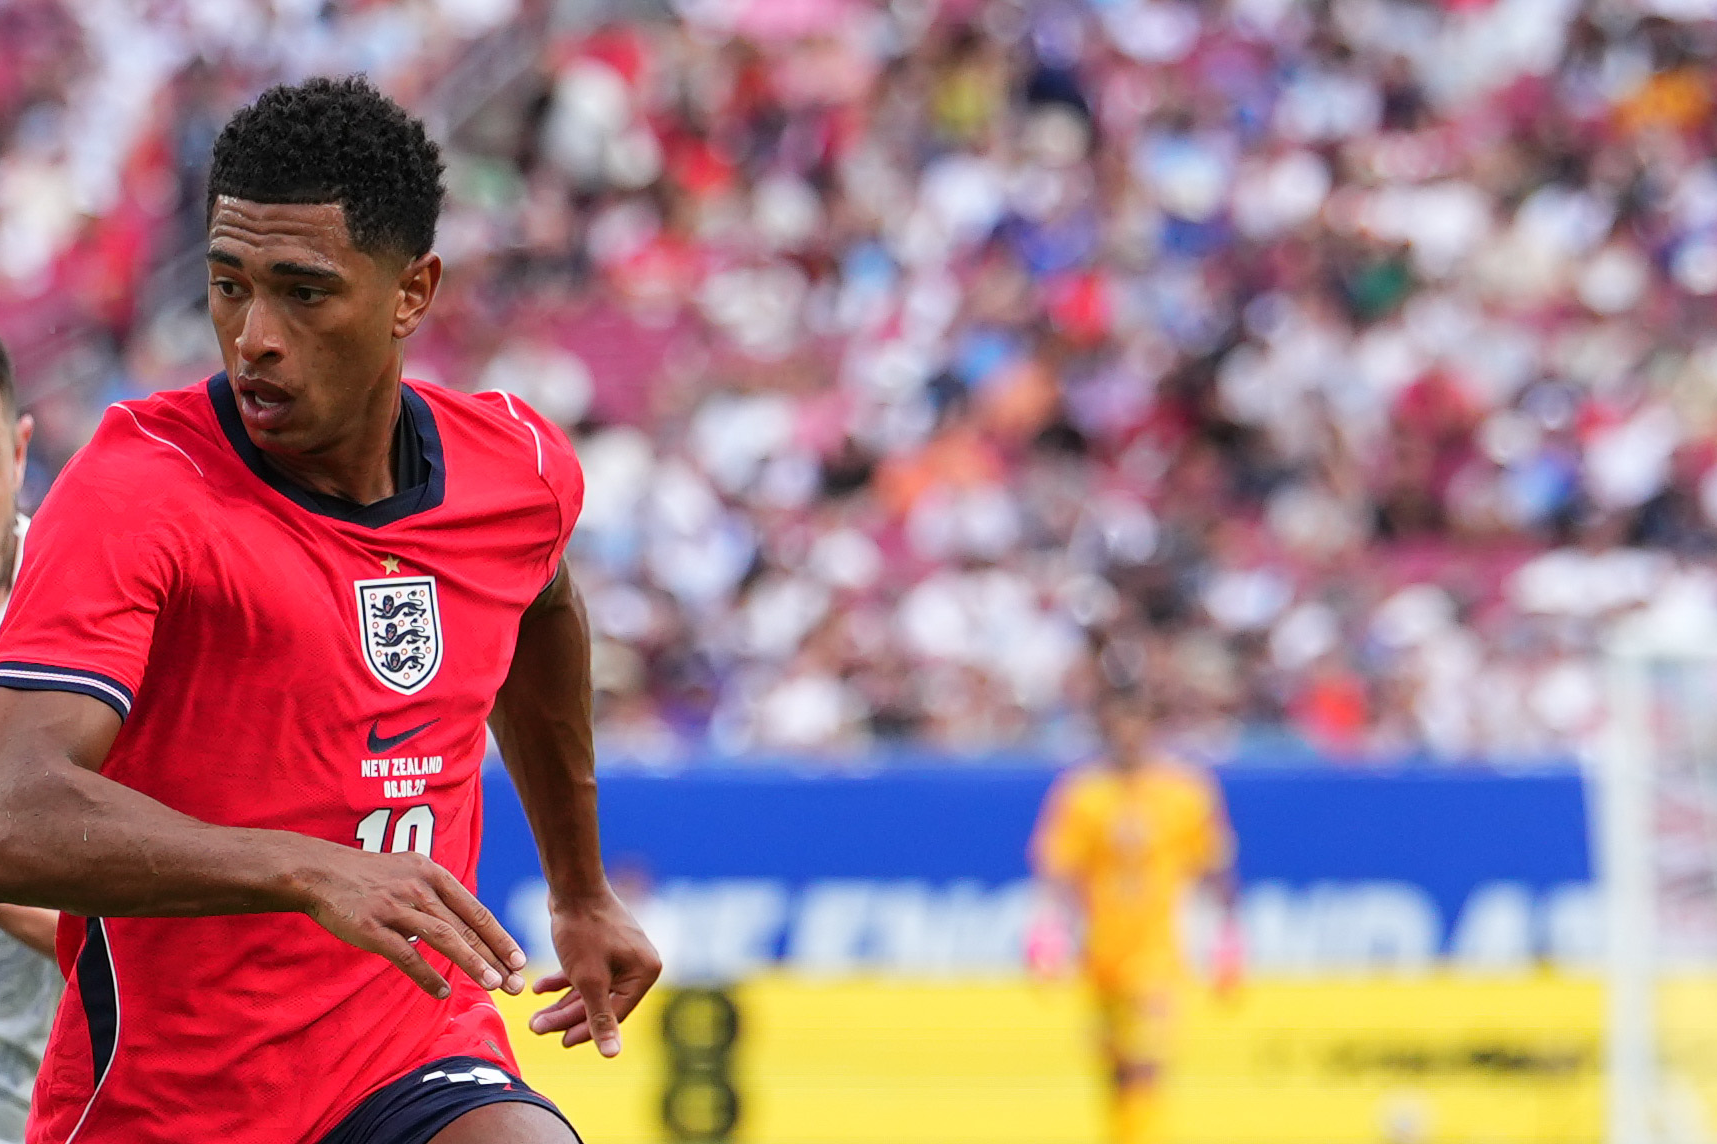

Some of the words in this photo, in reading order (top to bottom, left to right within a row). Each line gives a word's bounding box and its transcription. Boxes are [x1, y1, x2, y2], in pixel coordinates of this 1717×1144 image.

[361, 759, 390, 777] NEW
[391, 756, 443, 776] ZEALAND
[383, 779, 427, 798] 06.06.26
